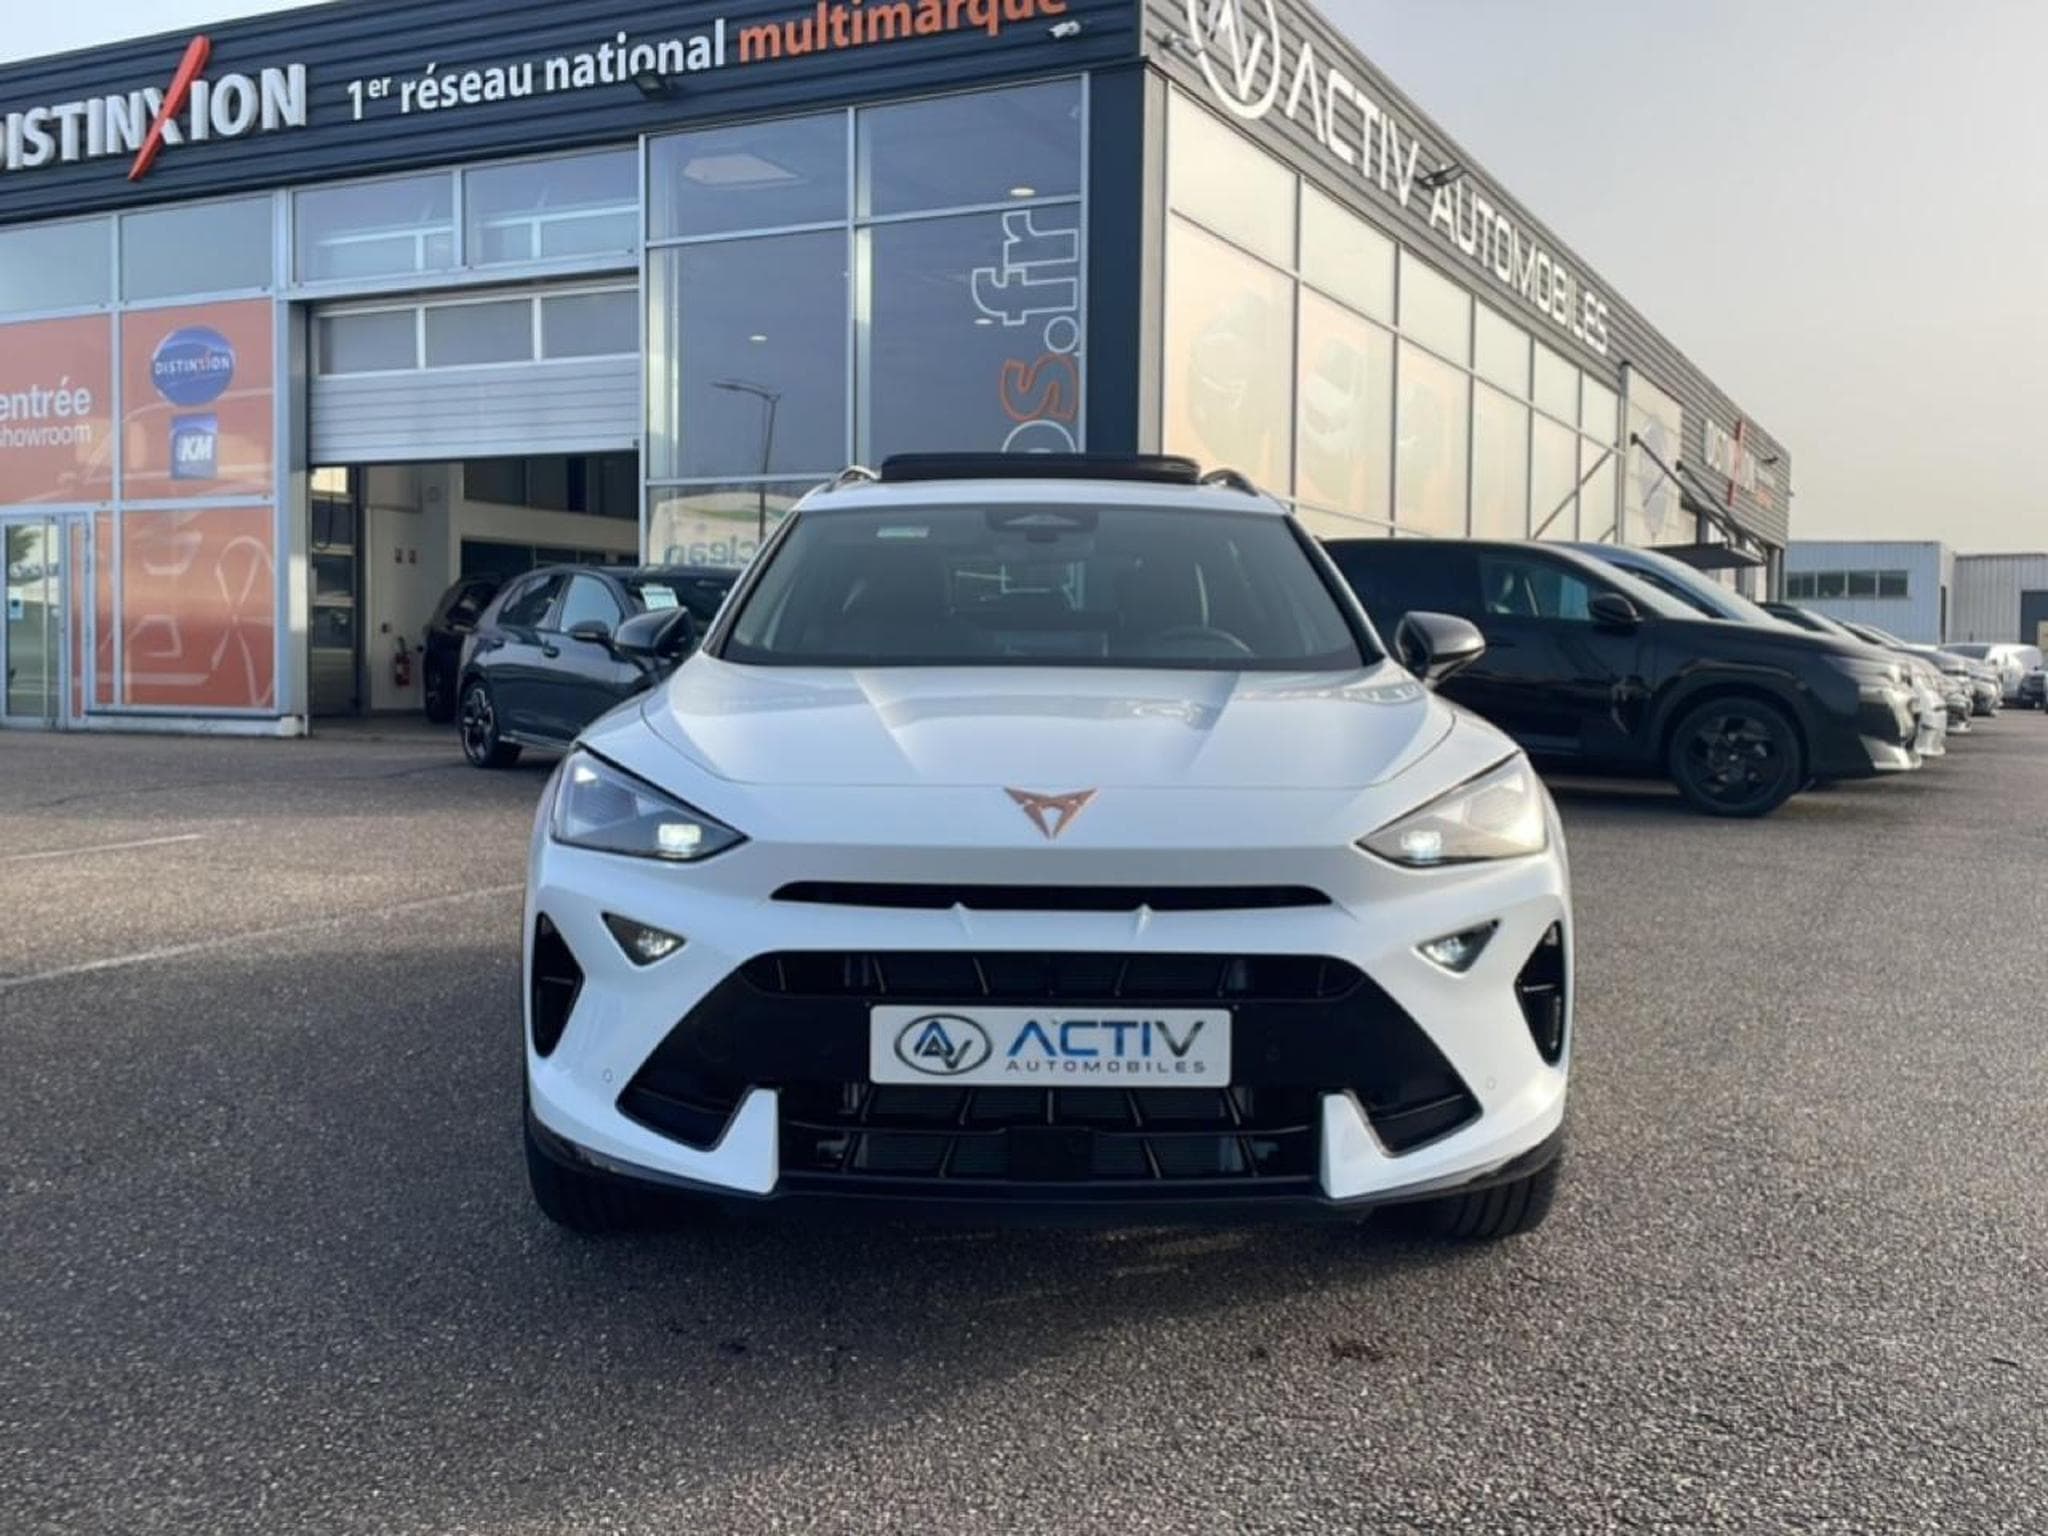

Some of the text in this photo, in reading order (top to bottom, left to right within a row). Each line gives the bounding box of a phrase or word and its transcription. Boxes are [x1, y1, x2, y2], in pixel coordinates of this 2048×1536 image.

[401, 62, 533, 113] réseau
[545, 18, 726, 92] national
[0, 35, 308, 181] ISTINXION
[1285, 41, 1418, 207] ACTIV
[1429, 163, 1609, 355] AUTOMOBILES
[0, 376, 91, 421] entrée
[0, 423, 91, 447] howroom
[1005, 1019, 1205, 1058] ACTIV
[1005, 1060, 1206, 1074] AUTOMOBILES
